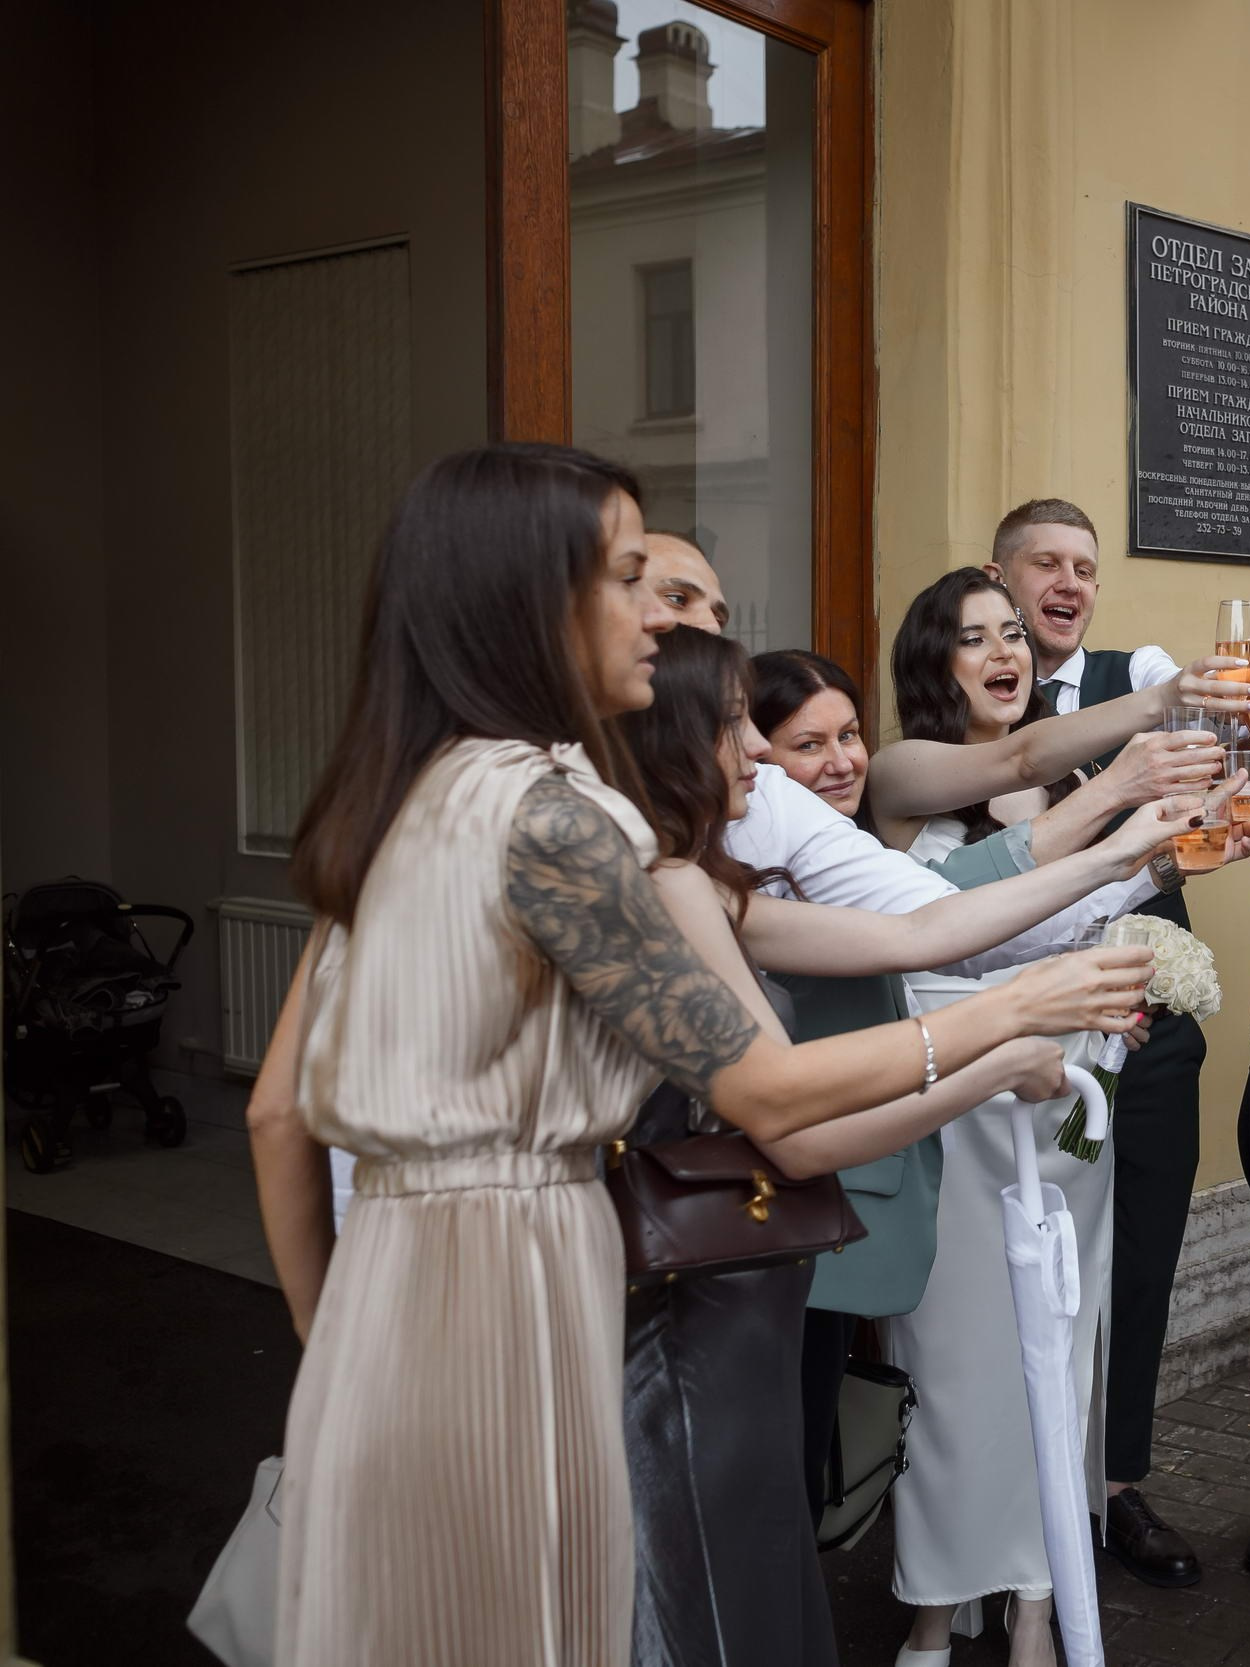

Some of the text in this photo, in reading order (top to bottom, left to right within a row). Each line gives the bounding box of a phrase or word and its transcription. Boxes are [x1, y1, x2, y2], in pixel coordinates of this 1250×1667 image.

[1152, 235, 1223, 272] ОТДЕЛ
[1190, 292, 1249, 321] РАЙОНА
[1167, 317, 1210, 339] ПРИЕМ
[1162, 338, 1196, 353] ВТОРНИК
[1198, 345, 1232, 360] ПЯТНИЦА
[1181, 355, 1214, 369] СУББОТА
[1181, 369, 1215, 384] ПЕРЕРЫВ
[1167, 384, 1210, 404] ПРИЕМ
[1179, 421, 1226, 440] ОТДЕЛА
[1183, 444, 1215, 457] ВТОРНИК
[1182, 459, 1214, 471] ЧЕТВЕРГ
[1184, 486, 1233, 500] САНИТАРНЫЙ
[1148, 495, 1194, 508] ПОСЛЕДНИЙ
[1196, 499, 1228, 511] РАБОЧИЙ
[1230, 503, 1249, 513] ДЕНЬ
[1174, 508, 1209, 520] ТЕЛЕФОН
[1211, 512, 1239, 523] ОТДЕЛА
